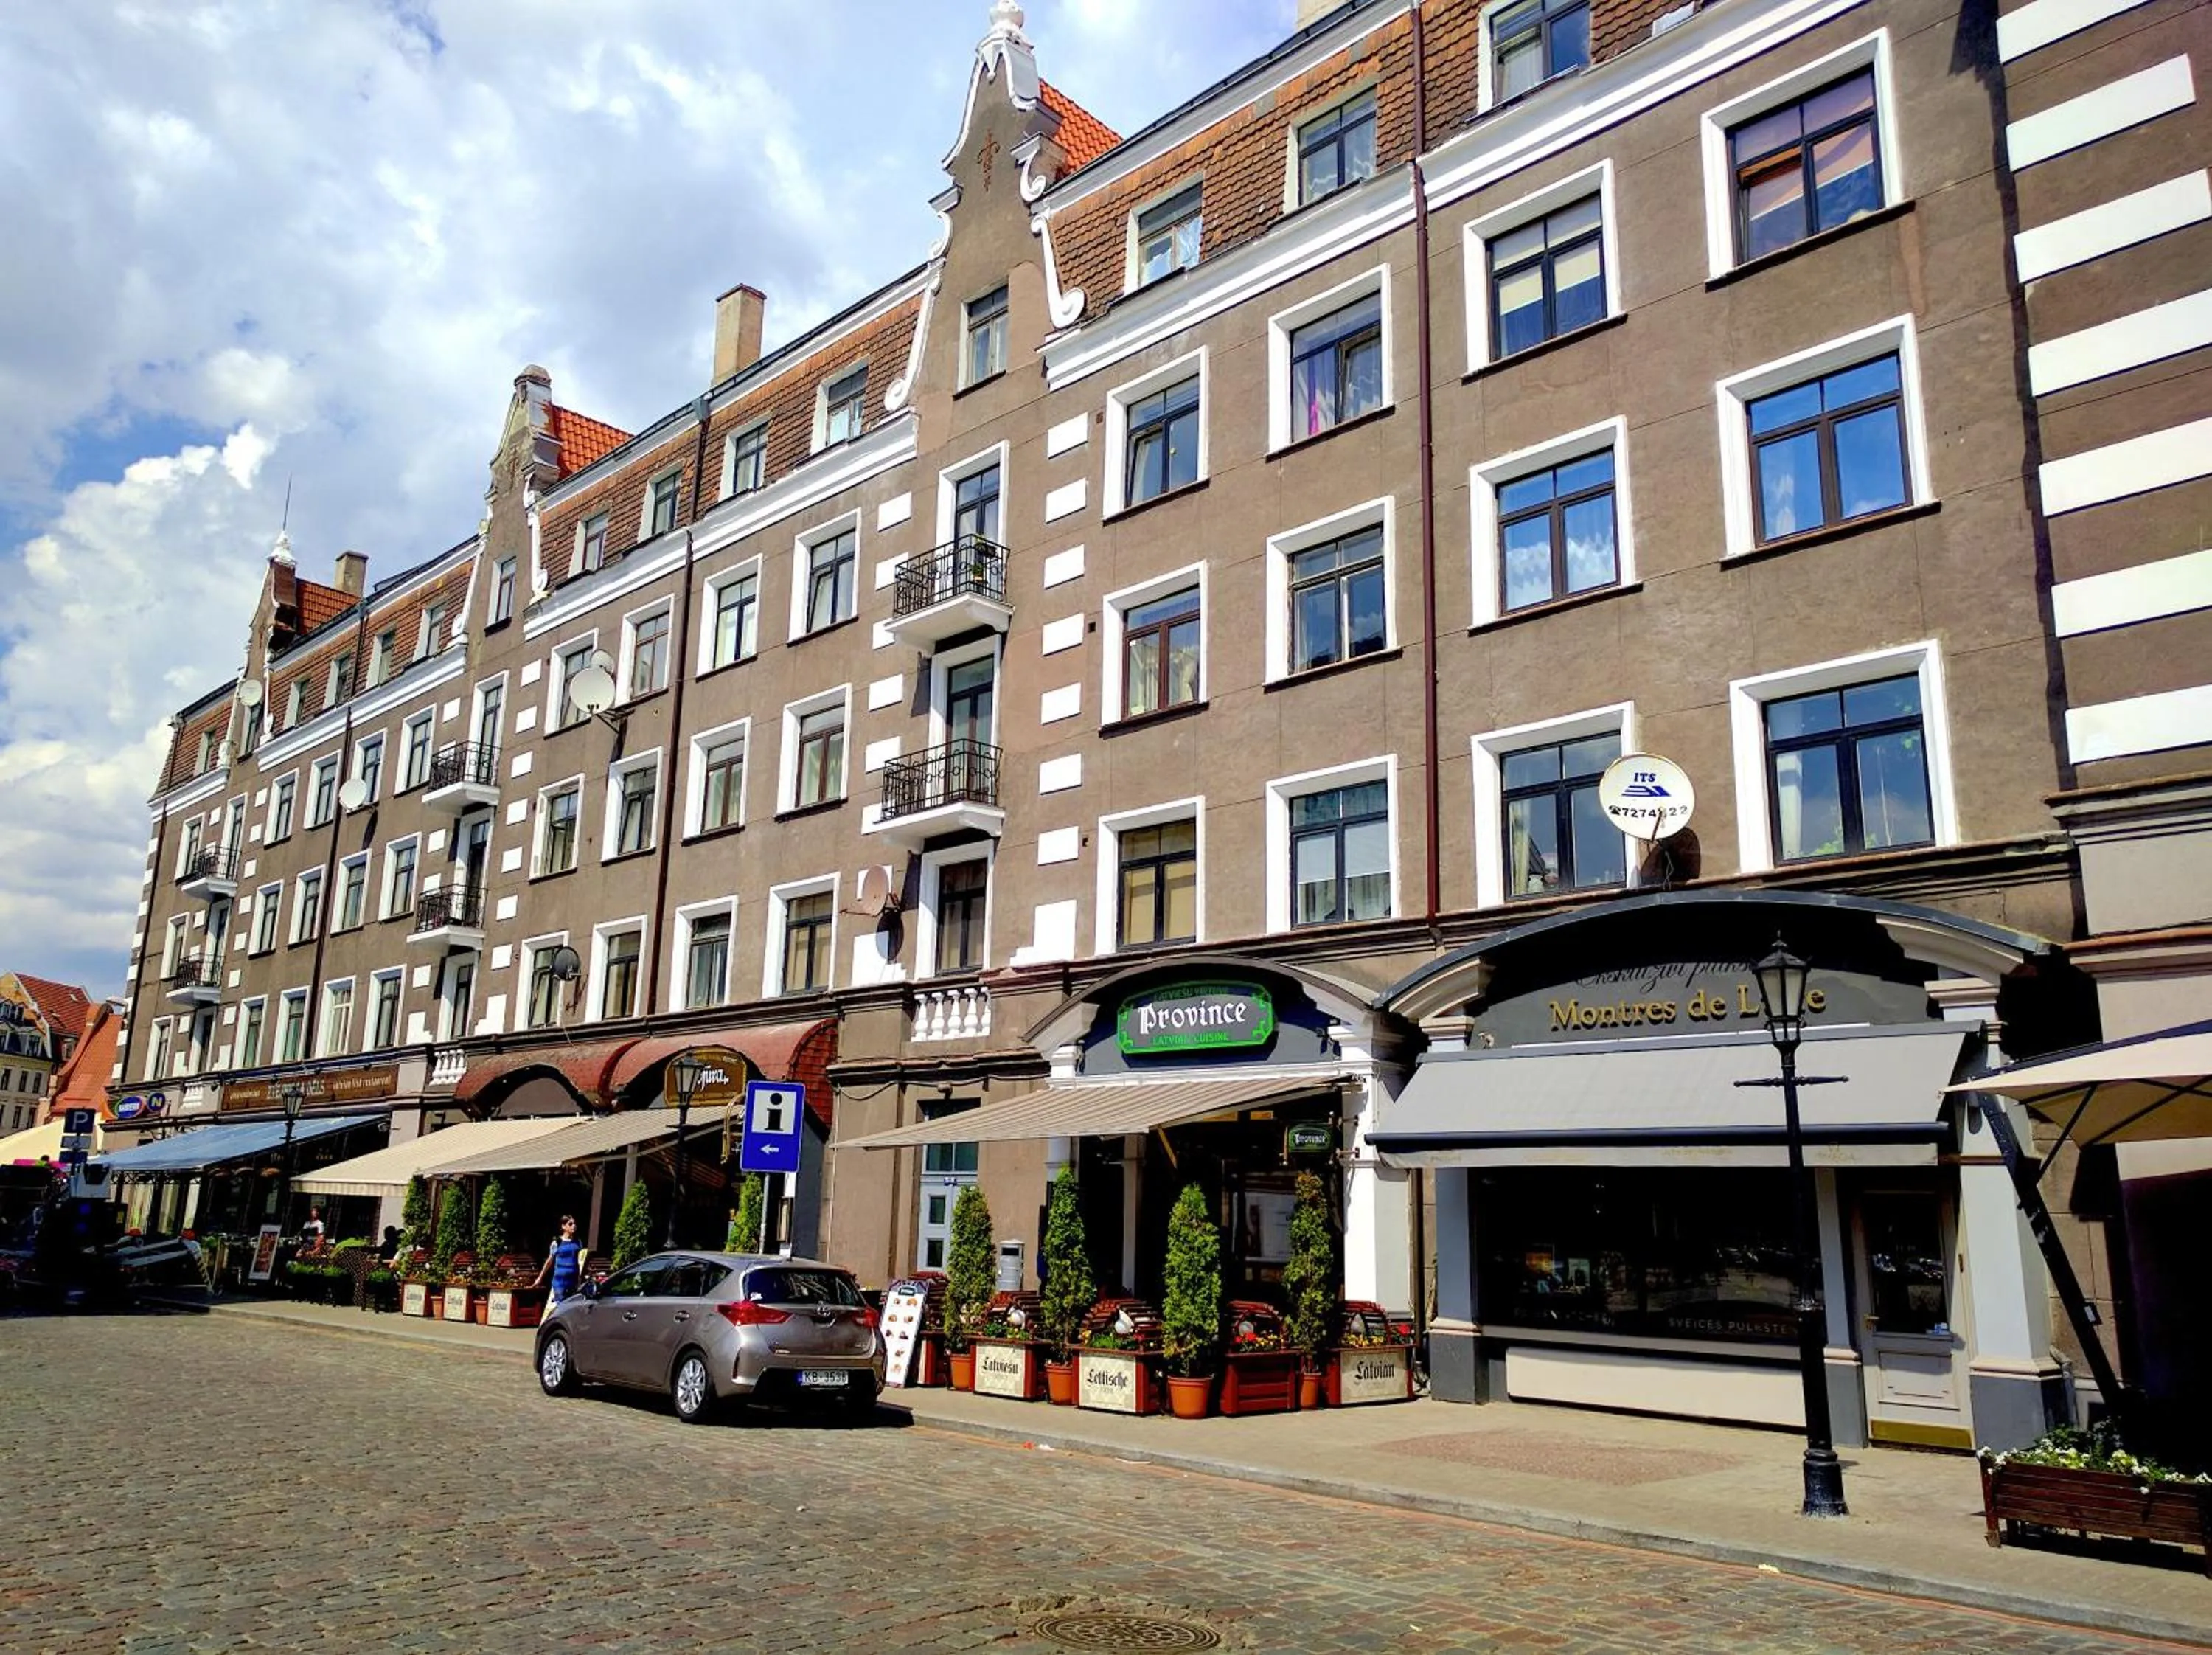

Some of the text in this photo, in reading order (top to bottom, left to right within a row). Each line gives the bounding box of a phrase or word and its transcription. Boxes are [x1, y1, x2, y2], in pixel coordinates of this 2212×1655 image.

[1633, 772, 1657, 783] ITS
[1550, 982, 1826, 1031] Montres de Le
[1138, 999, 1247, 1035] Province
[1152, 1031, 1229, 1046] LATVIAN CUISINE
[151, 1097, 163, 1107] N
[72, 1111, 88, 1131] P
[1086, 1368, 1130, 1390] Lettische
[1354, 1360, 1395, 1381] Latvian
